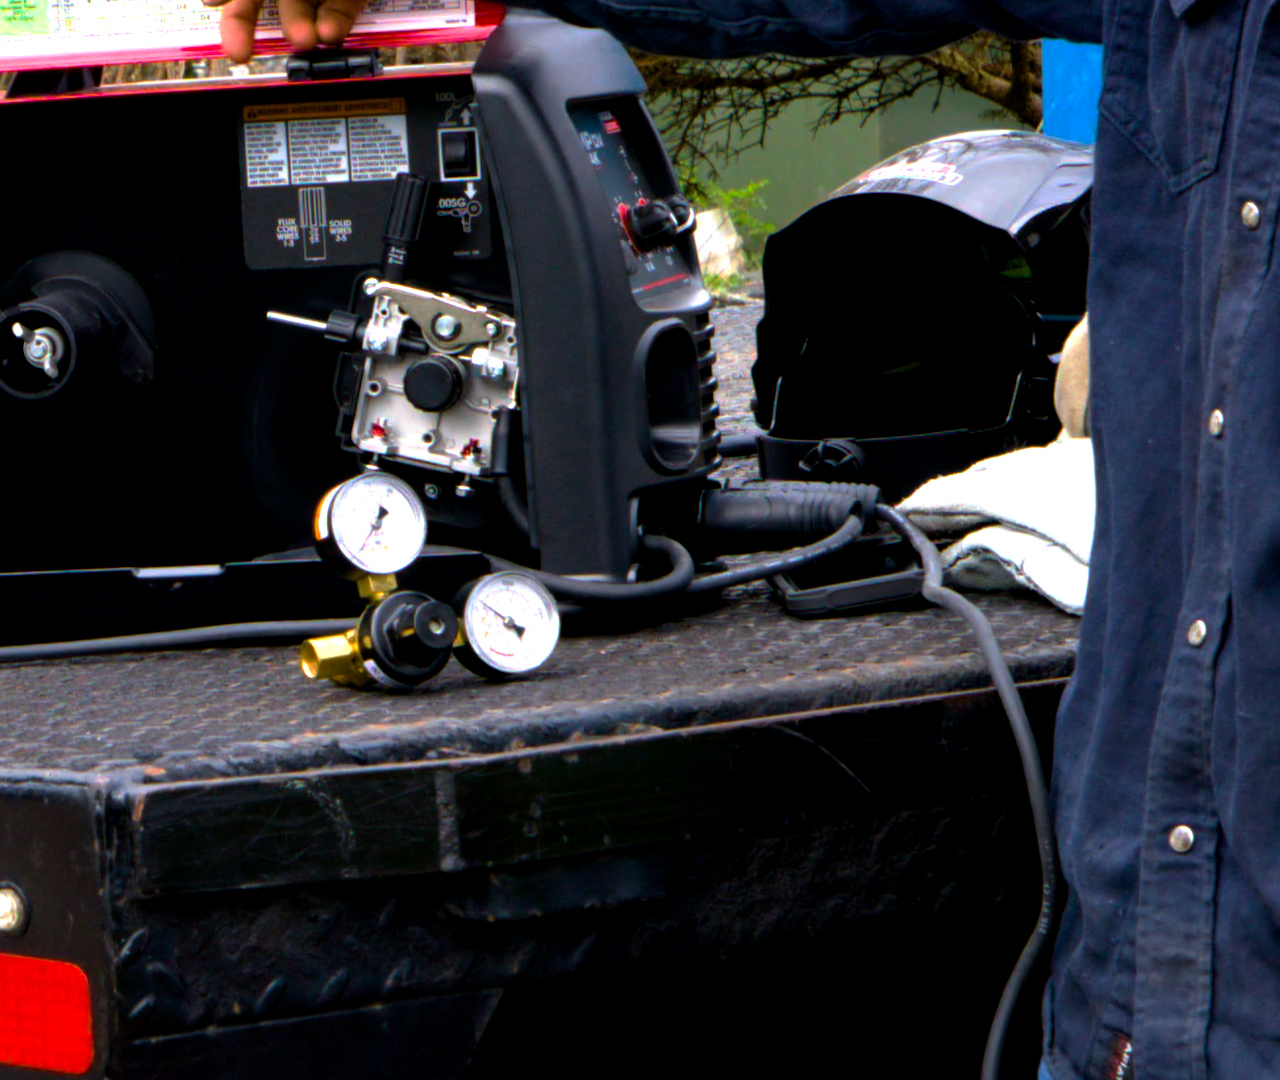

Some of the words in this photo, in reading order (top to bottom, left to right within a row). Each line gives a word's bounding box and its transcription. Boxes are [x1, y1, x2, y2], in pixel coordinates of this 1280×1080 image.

[437, 197, 467, 209] 00SG
[277, 218, 296, 226] FLUX
[329, 219, 352, 227] SOLID
[276, 225, 298, 233] CORE
[329, 226, 353, 235] WIRES
[276, 232, 300, 241] WIRES
